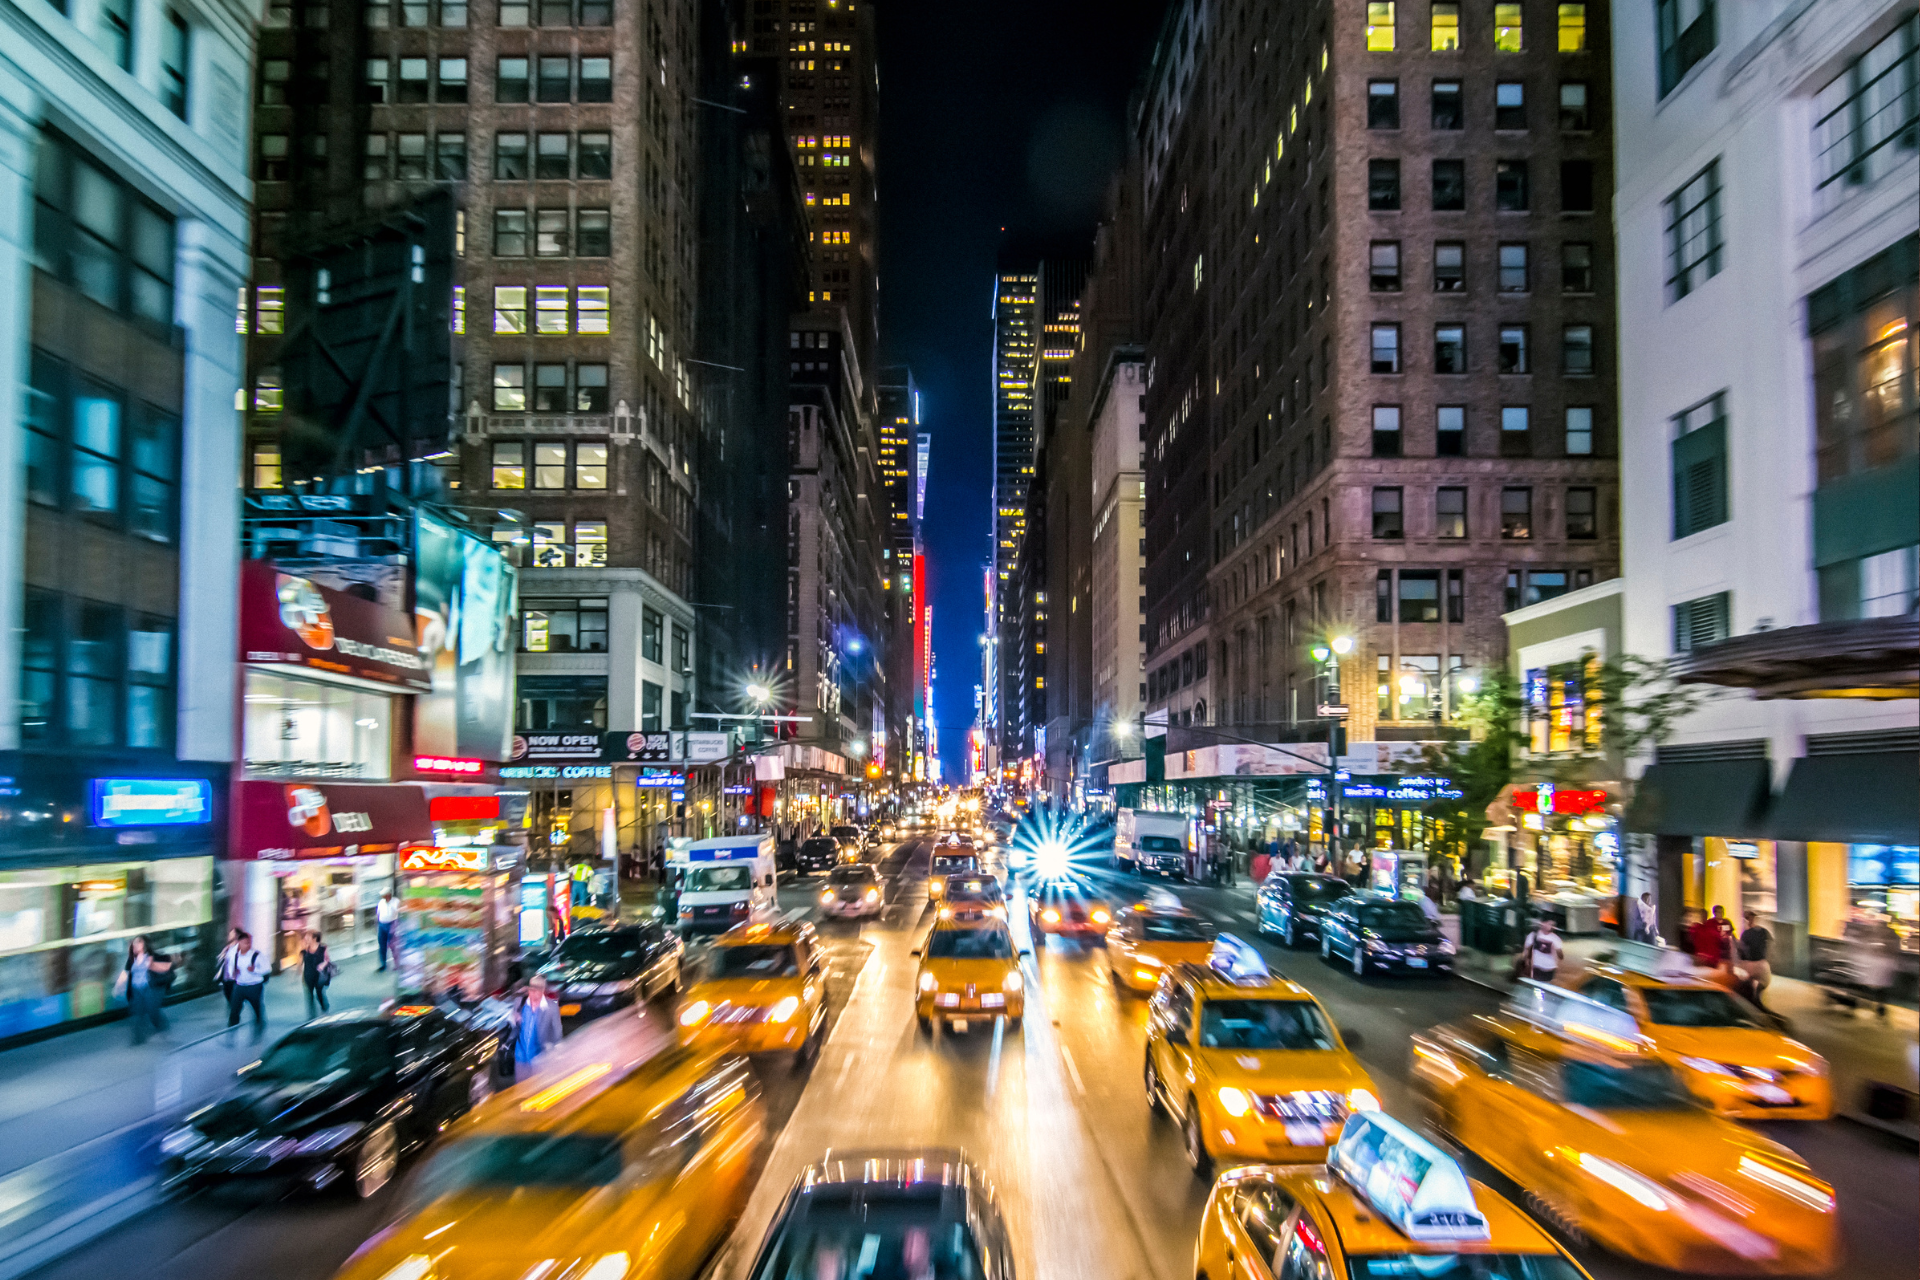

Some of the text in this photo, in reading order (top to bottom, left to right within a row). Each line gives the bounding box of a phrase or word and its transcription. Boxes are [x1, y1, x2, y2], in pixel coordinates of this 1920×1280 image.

[528, 735, 598, 746] NOW OPEN
[646, 742, 669, 750] OPEN
[562, 766, 612, 778] COFFEE
[1387, 788, 1430, 799] coffee
